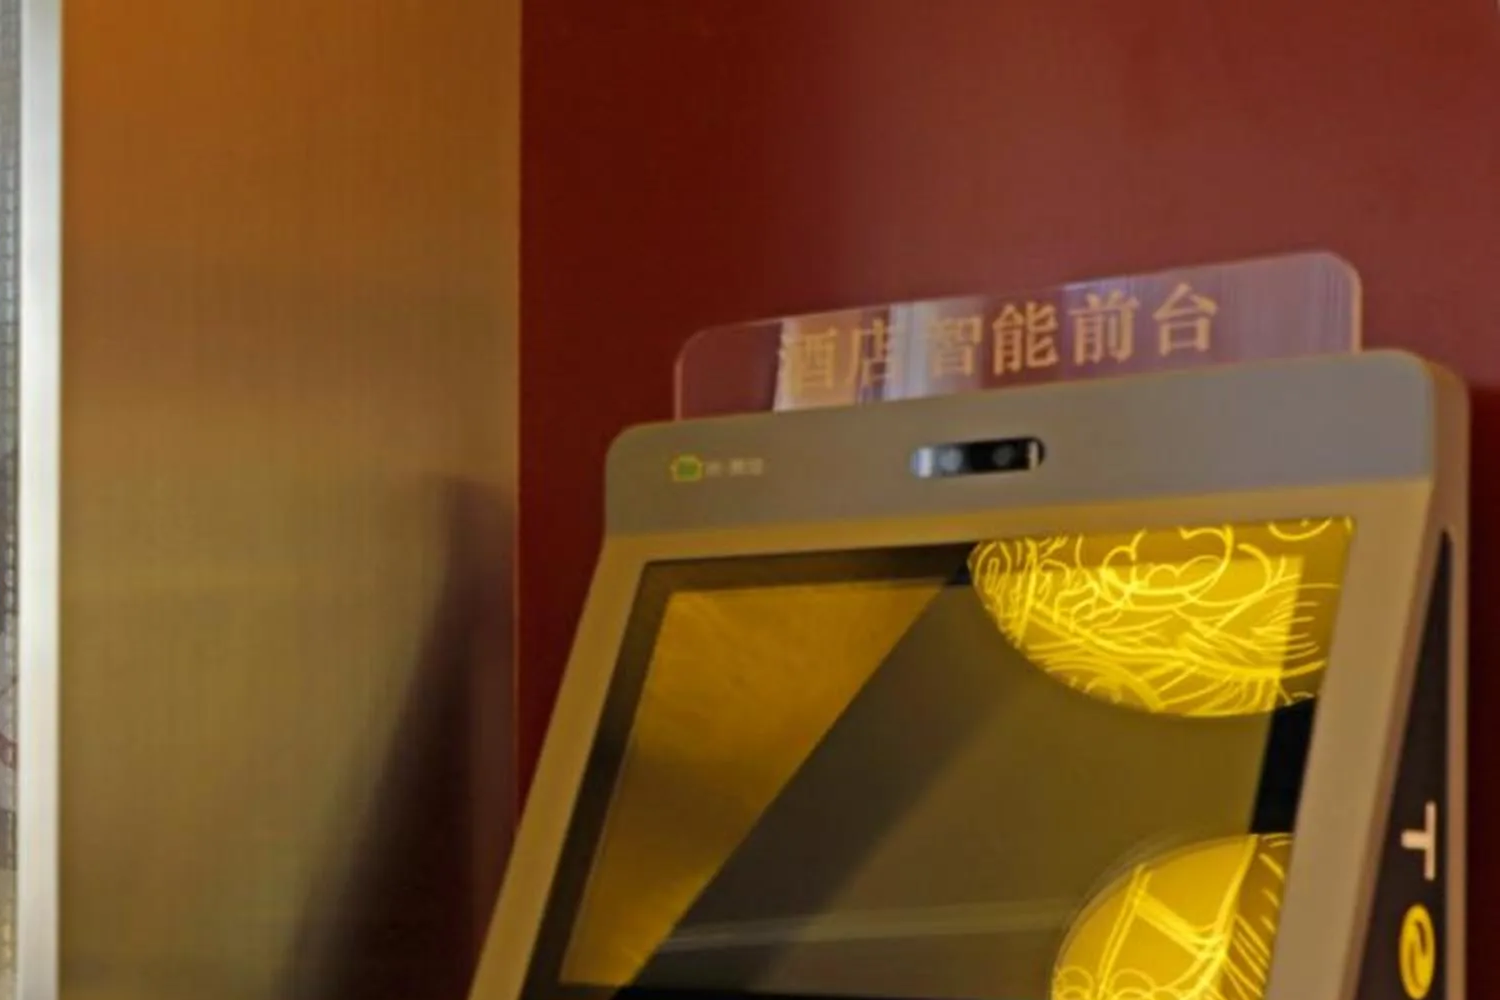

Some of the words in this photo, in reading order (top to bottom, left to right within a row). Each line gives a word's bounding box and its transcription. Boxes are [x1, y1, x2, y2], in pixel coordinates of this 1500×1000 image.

[778, 282, 1218, 394] 酒店智能前台
